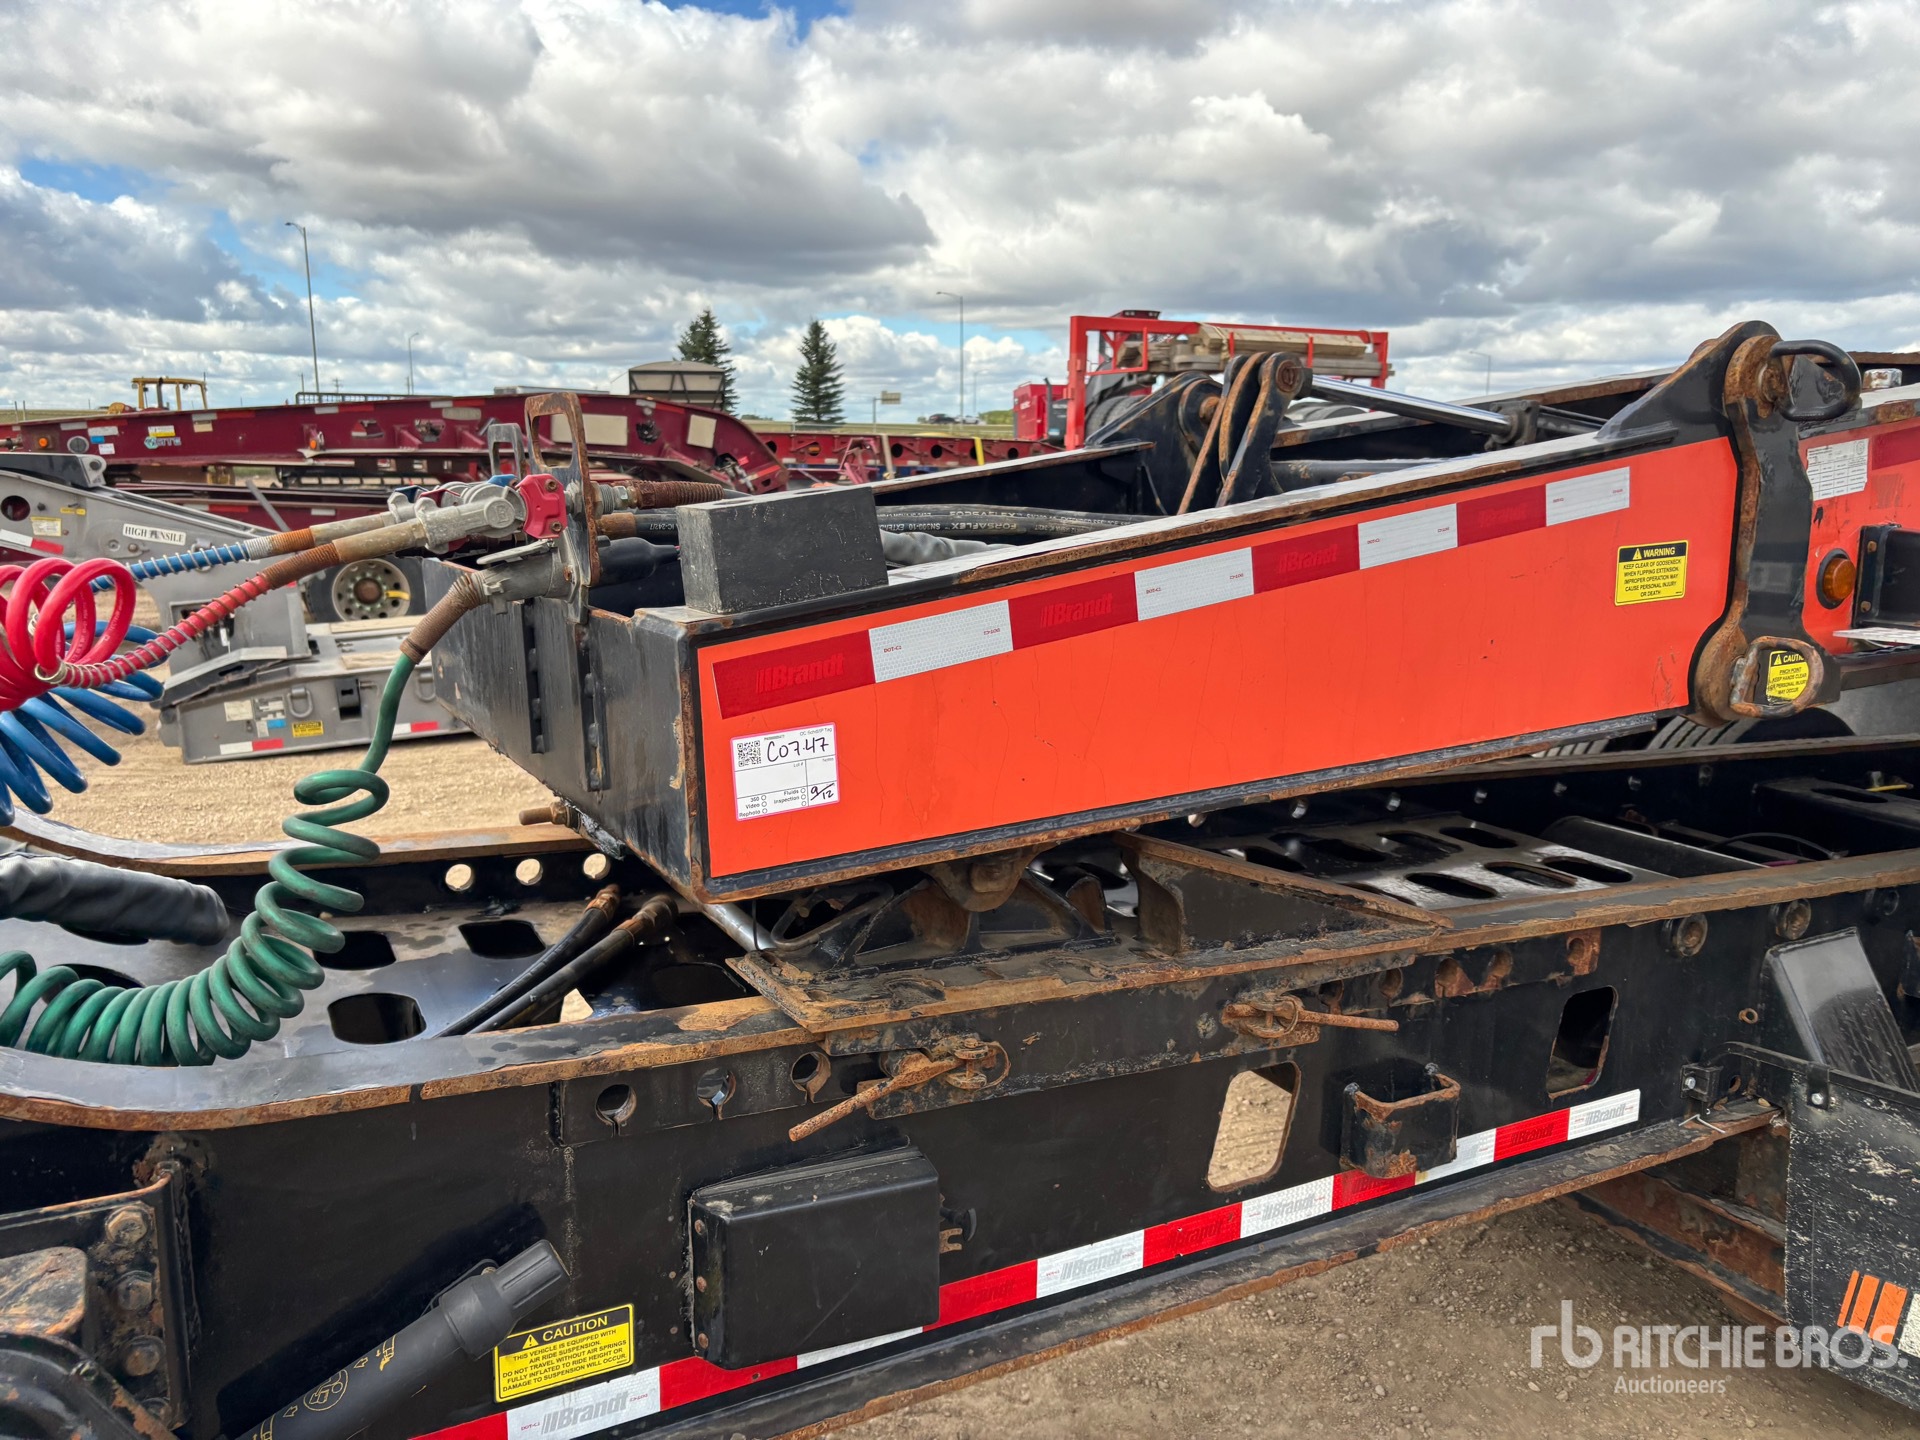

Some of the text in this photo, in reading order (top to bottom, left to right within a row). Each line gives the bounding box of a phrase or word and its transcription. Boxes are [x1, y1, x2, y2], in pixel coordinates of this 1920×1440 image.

[125, 526, 147, 537] HIGH
[951, 522, 1017, 530] FORSAFLEX
[1643, 547, 1676, 558] WARNING
[1053, 592, 1113, 624] Brandt
[772, 652, 844, 692] Brandt
[773, 795, 800, 804] Inspection
[810, 783, 835, 800] 9/12
[1592, 1103, 1626, 1122] Brandt
[1518, 1123, 1555, 1143] Brandt
[1273, 1193, 1316, 1218] Brandt
[1178, 1218, 1224, 1245] Brandt
[1072, 1249, 1123, 1278] Brandt
[542, 1315, 608, 1342] CAUTION
[502, 1339, 627, 1378] DO NOT TRAVEL WITHOUT AIR SPRINGS
[514, 1352, 529, 1361] THIS
[529, 1344, 558, 1357] VEHICLE
[566, 1333, 600, 1347] EQUIPPED
[601, 1329, 616, 1339] WITH
[529, 1340, 601, 1365] AIR RIDE SUSPENSION.
[502, 1379, 532, 1393] DAMAGE
[533, 1377, 542, 1385] TO
[543, 1365, 585, 1382] SUSPENSION
[586, 1360, 602, 1370] WILL
[507, 1373, 528, 1385] FULLY
[529, 1365, 560, 1379] INFLATED
[561, 1362, 570, 1370] TO
[572, 1357, 587, 1367] RIDE
[588, 1351, 612, 1362] HEIGHT
[613, 1347, 623, 1355] OR
[557, 1391, 629, 1430] Brandt
